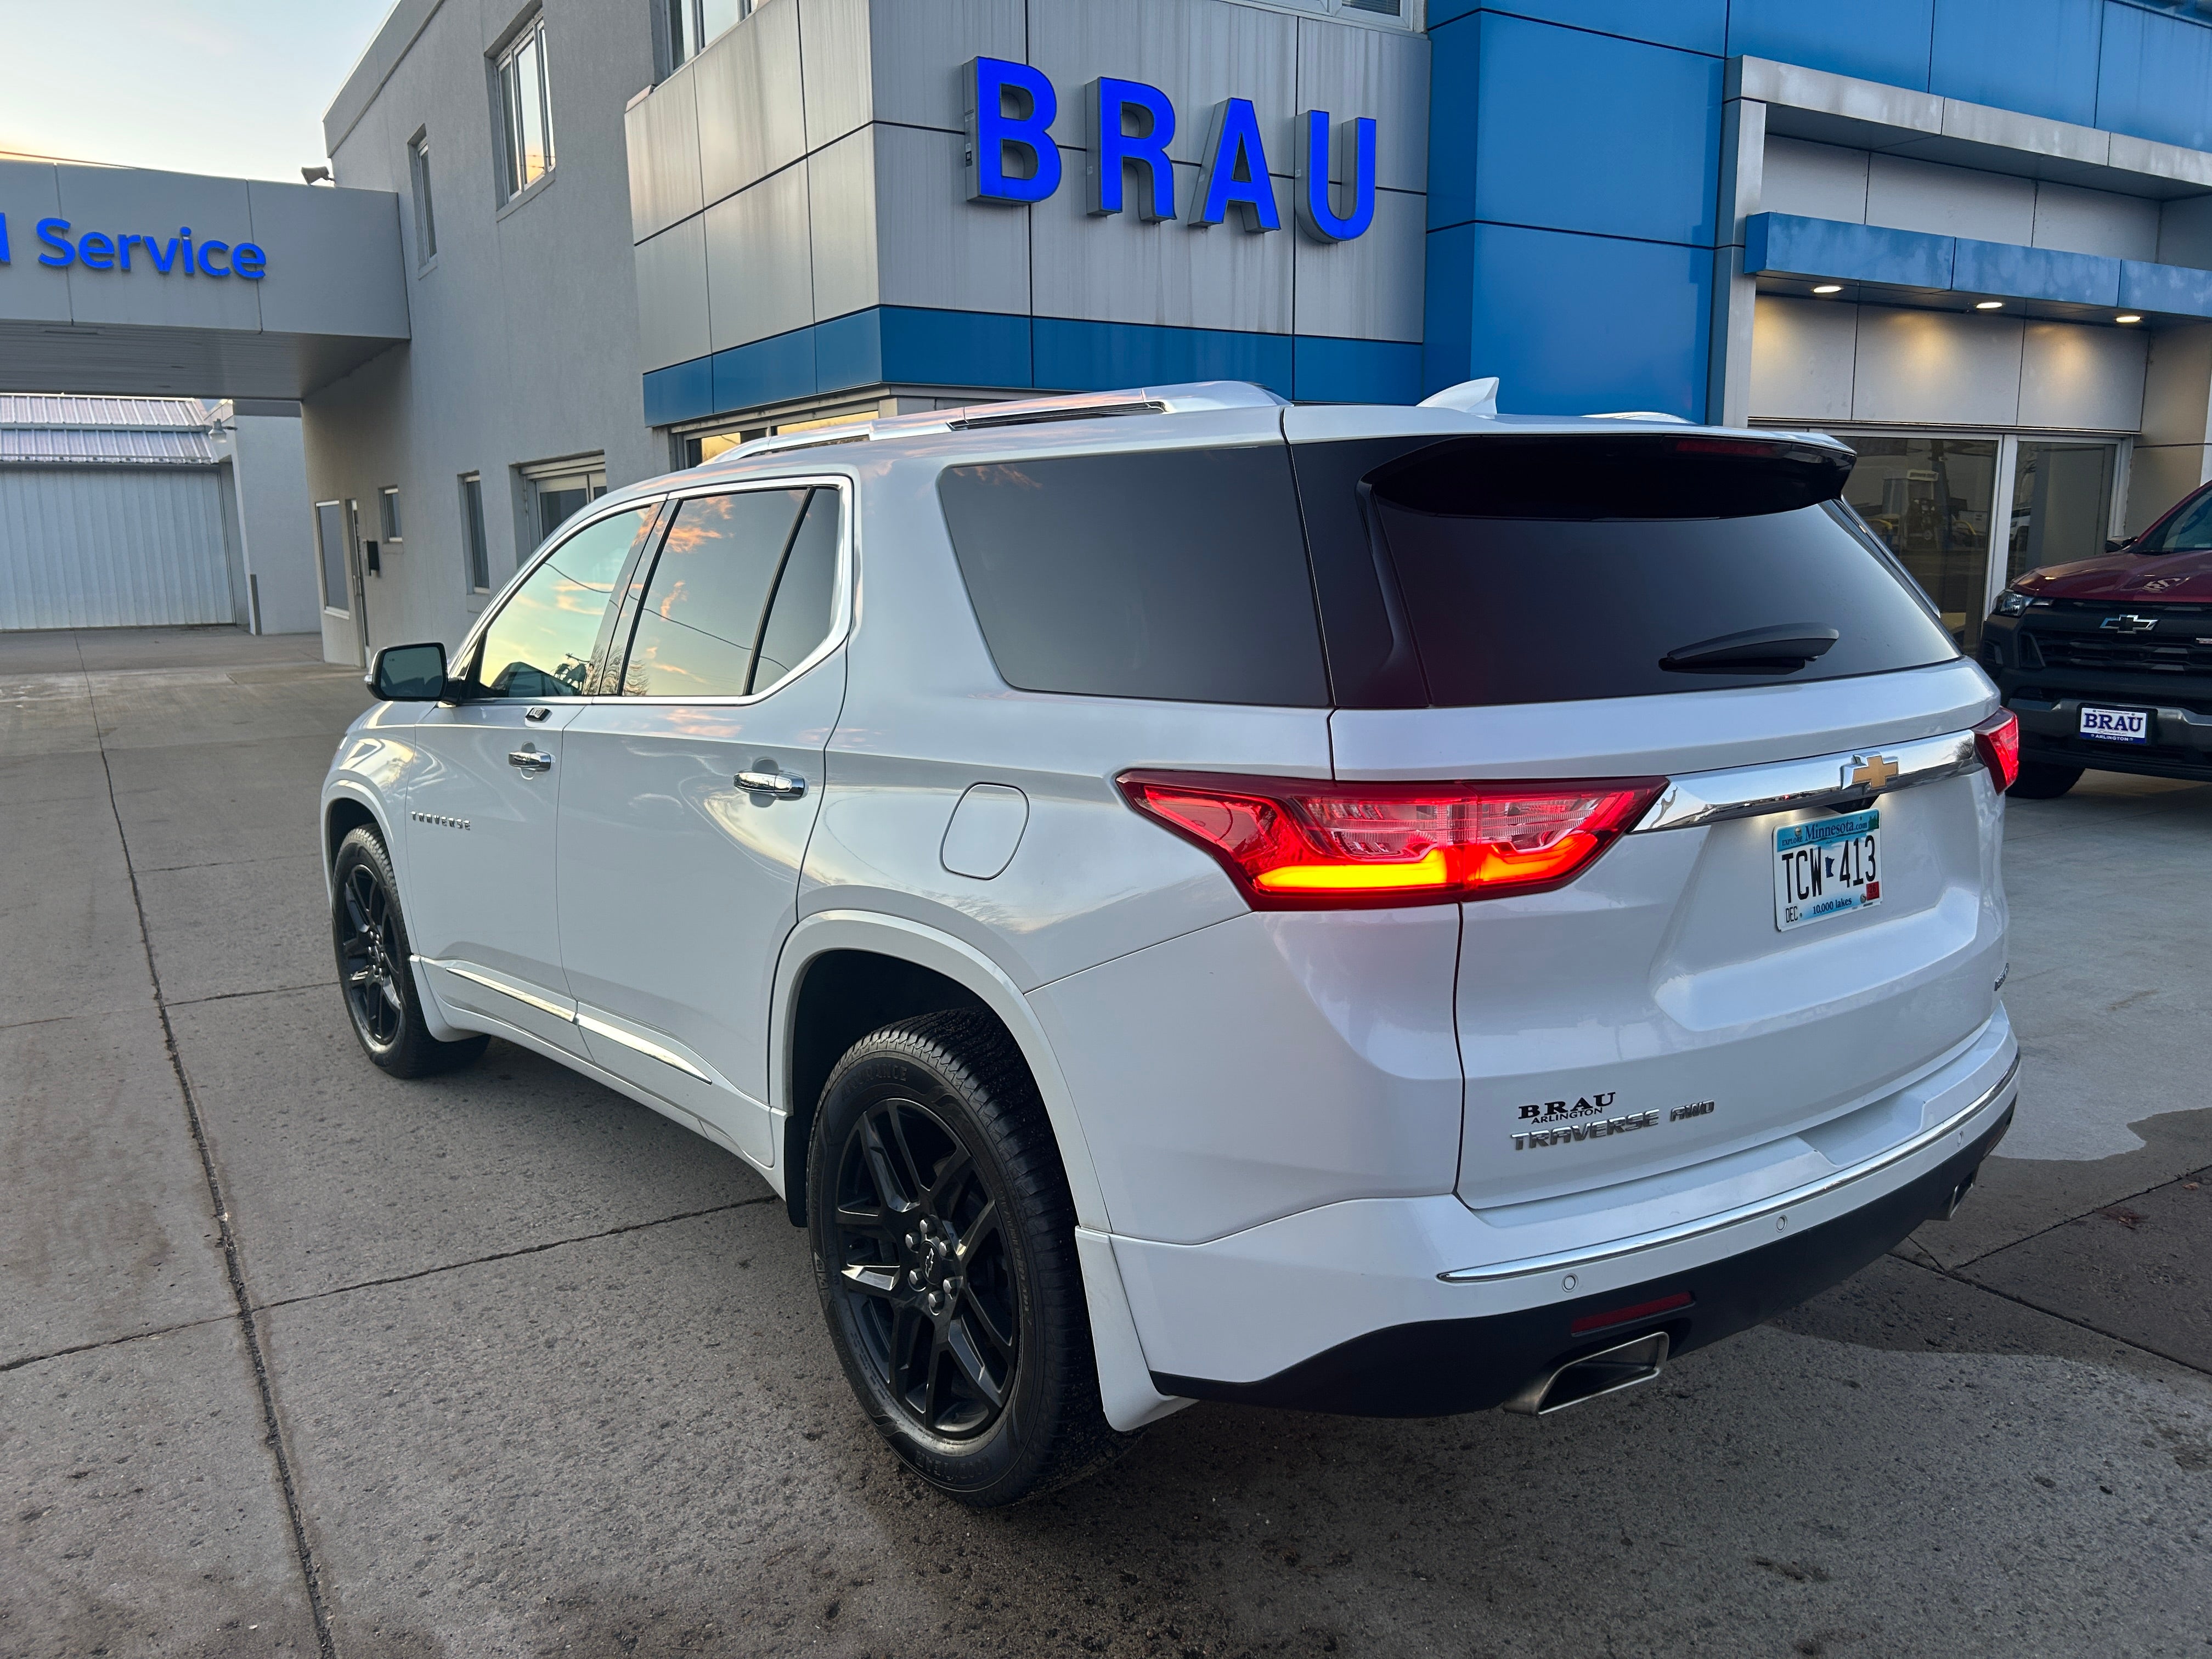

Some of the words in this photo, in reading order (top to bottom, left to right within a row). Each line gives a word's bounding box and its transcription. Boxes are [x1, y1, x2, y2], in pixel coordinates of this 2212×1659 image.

[964, 56, 1376, 243] BRAU
[36, 217, 266, 279] Service
[2084, 713, 2143, 732] BRAU
[410, 811, 470, 831] TRAVERSE
[1781, 836, 1803, 846] EXPLORE
[1781, 847, 1822, 904] TCW
[1839, 834, 1876, 888] 413
[1785, 906, 1798, 923] DEC
[1812, 901, 1834, 915] 10,000
[1835, 898, 1852, 909] lakes
[1518, 1091, 1616, 1120] BRAU
[1531, 1107, 1603, 1125] ARLINGTON
[1510, 1108, 1660, 1150] TRAVERSE
[1669, 1099, 1715, 1122] AWD
